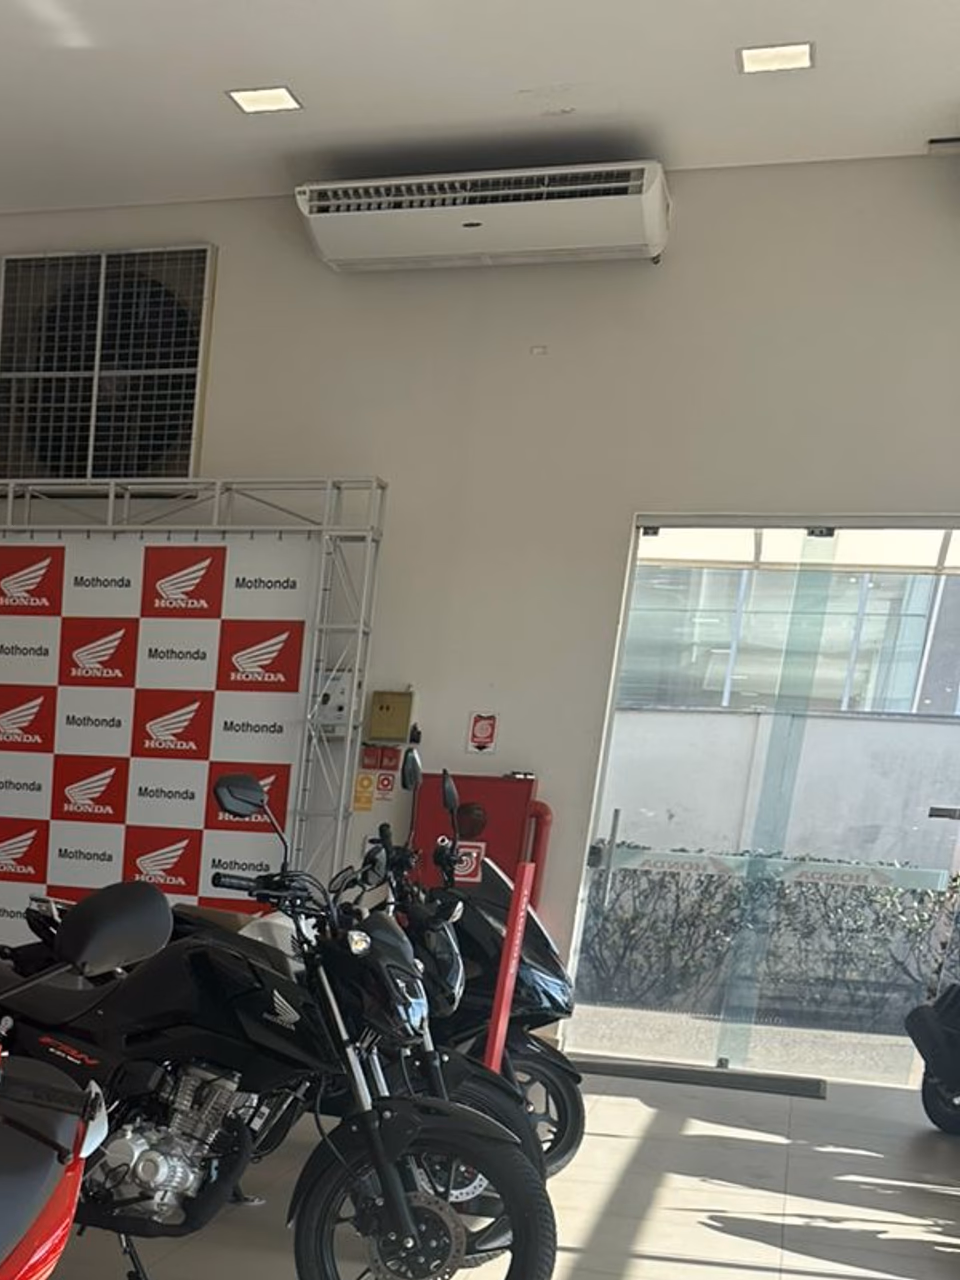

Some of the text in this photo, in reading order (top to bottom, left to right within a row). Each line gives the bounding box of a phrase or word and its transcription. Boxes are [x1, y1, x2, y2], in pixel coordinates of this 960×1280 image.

[74, 576, 131, 588] Mothonda
[235, 578, 297, 590] Mothonda
[0, 596, 49, 606] HONDA
[154, 598, 208, 608] HONDA
[148, 648, 206, 660] Mothonda
[71, 667, 123, 677] HONDA
[230, 671, 285, 682] HONDA
[66, 715, 121, 728] Mothonda
[223, 721, 283, 734] Mothonda
[144, 739, 197, 750] HONDA
[138, 787, 195, 800] Mothonda
[64, 803, 114, 814] HONDA
[59, 848, 113, 862] Mothonda
[211, 858, 270, 872] Mothonda
[135, 874, 186, 885] HONDA
